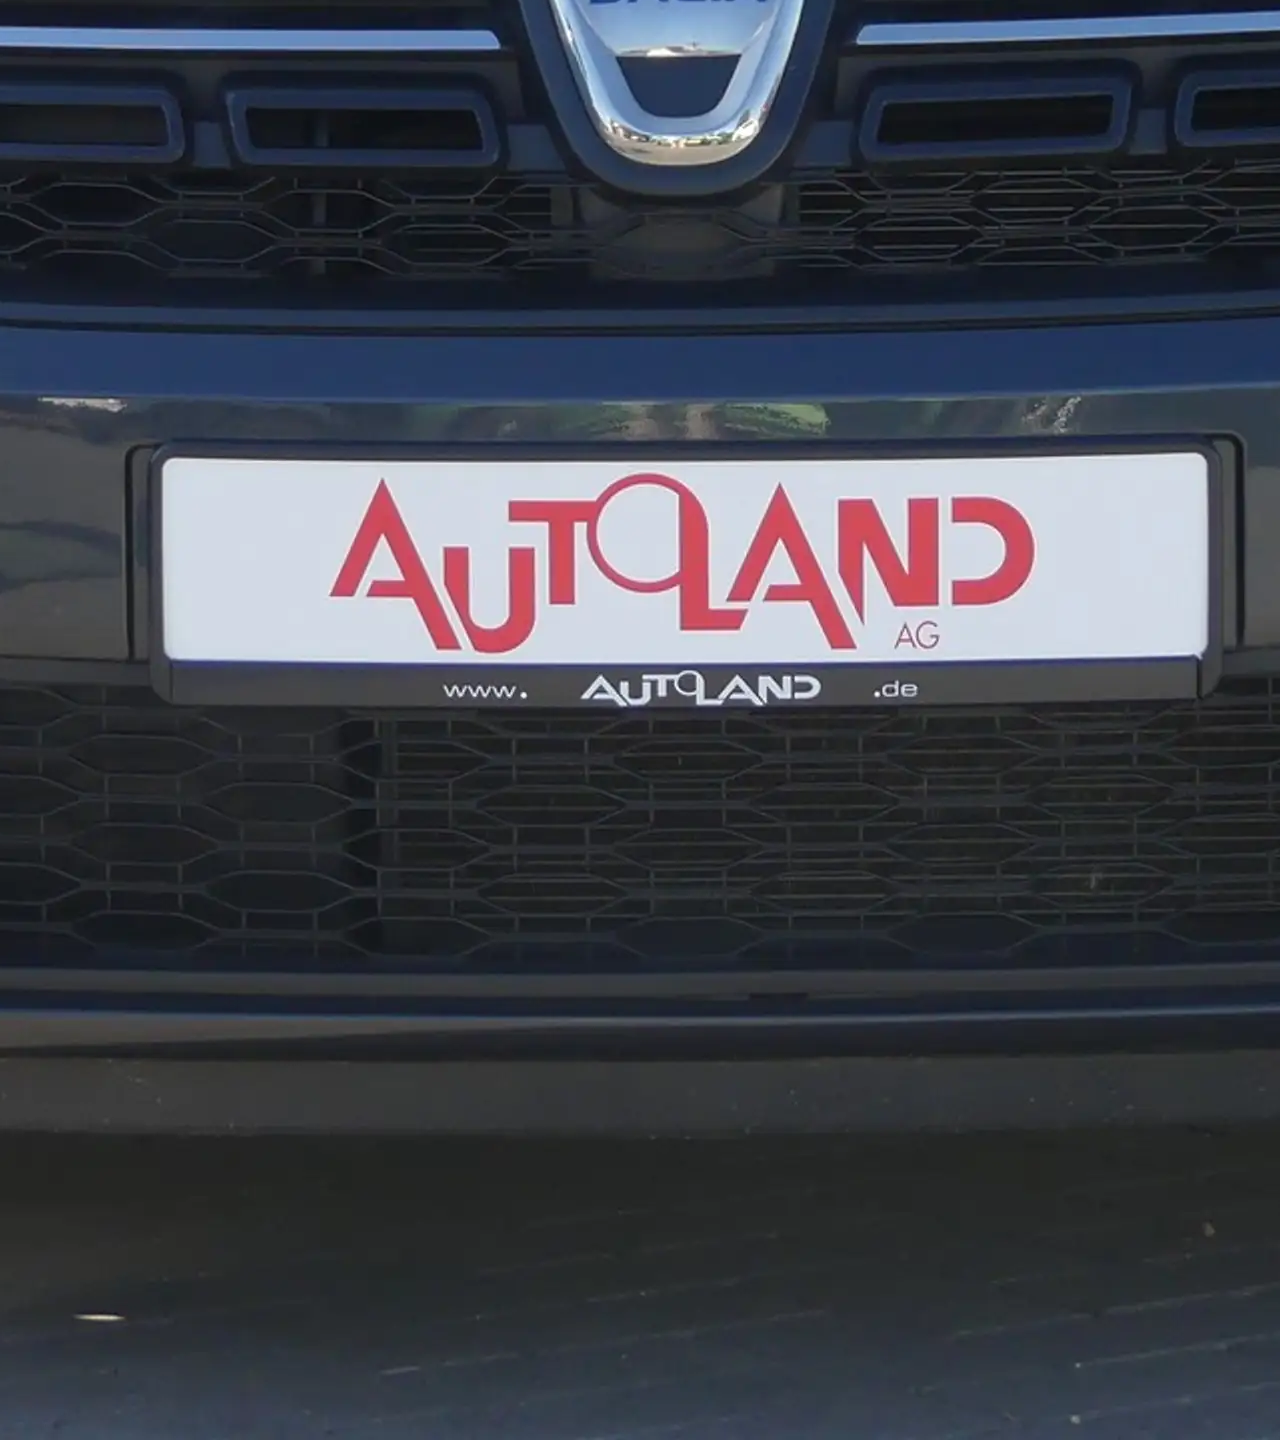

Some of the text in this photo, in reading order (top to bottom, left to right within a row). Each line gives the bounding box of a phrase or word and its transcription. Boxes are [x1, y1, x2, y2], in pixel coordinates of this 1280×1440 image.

[893, 620, 941, 650] AG
[442, 682, 528, 700] www.
[873, 679, 919, 699] .de
